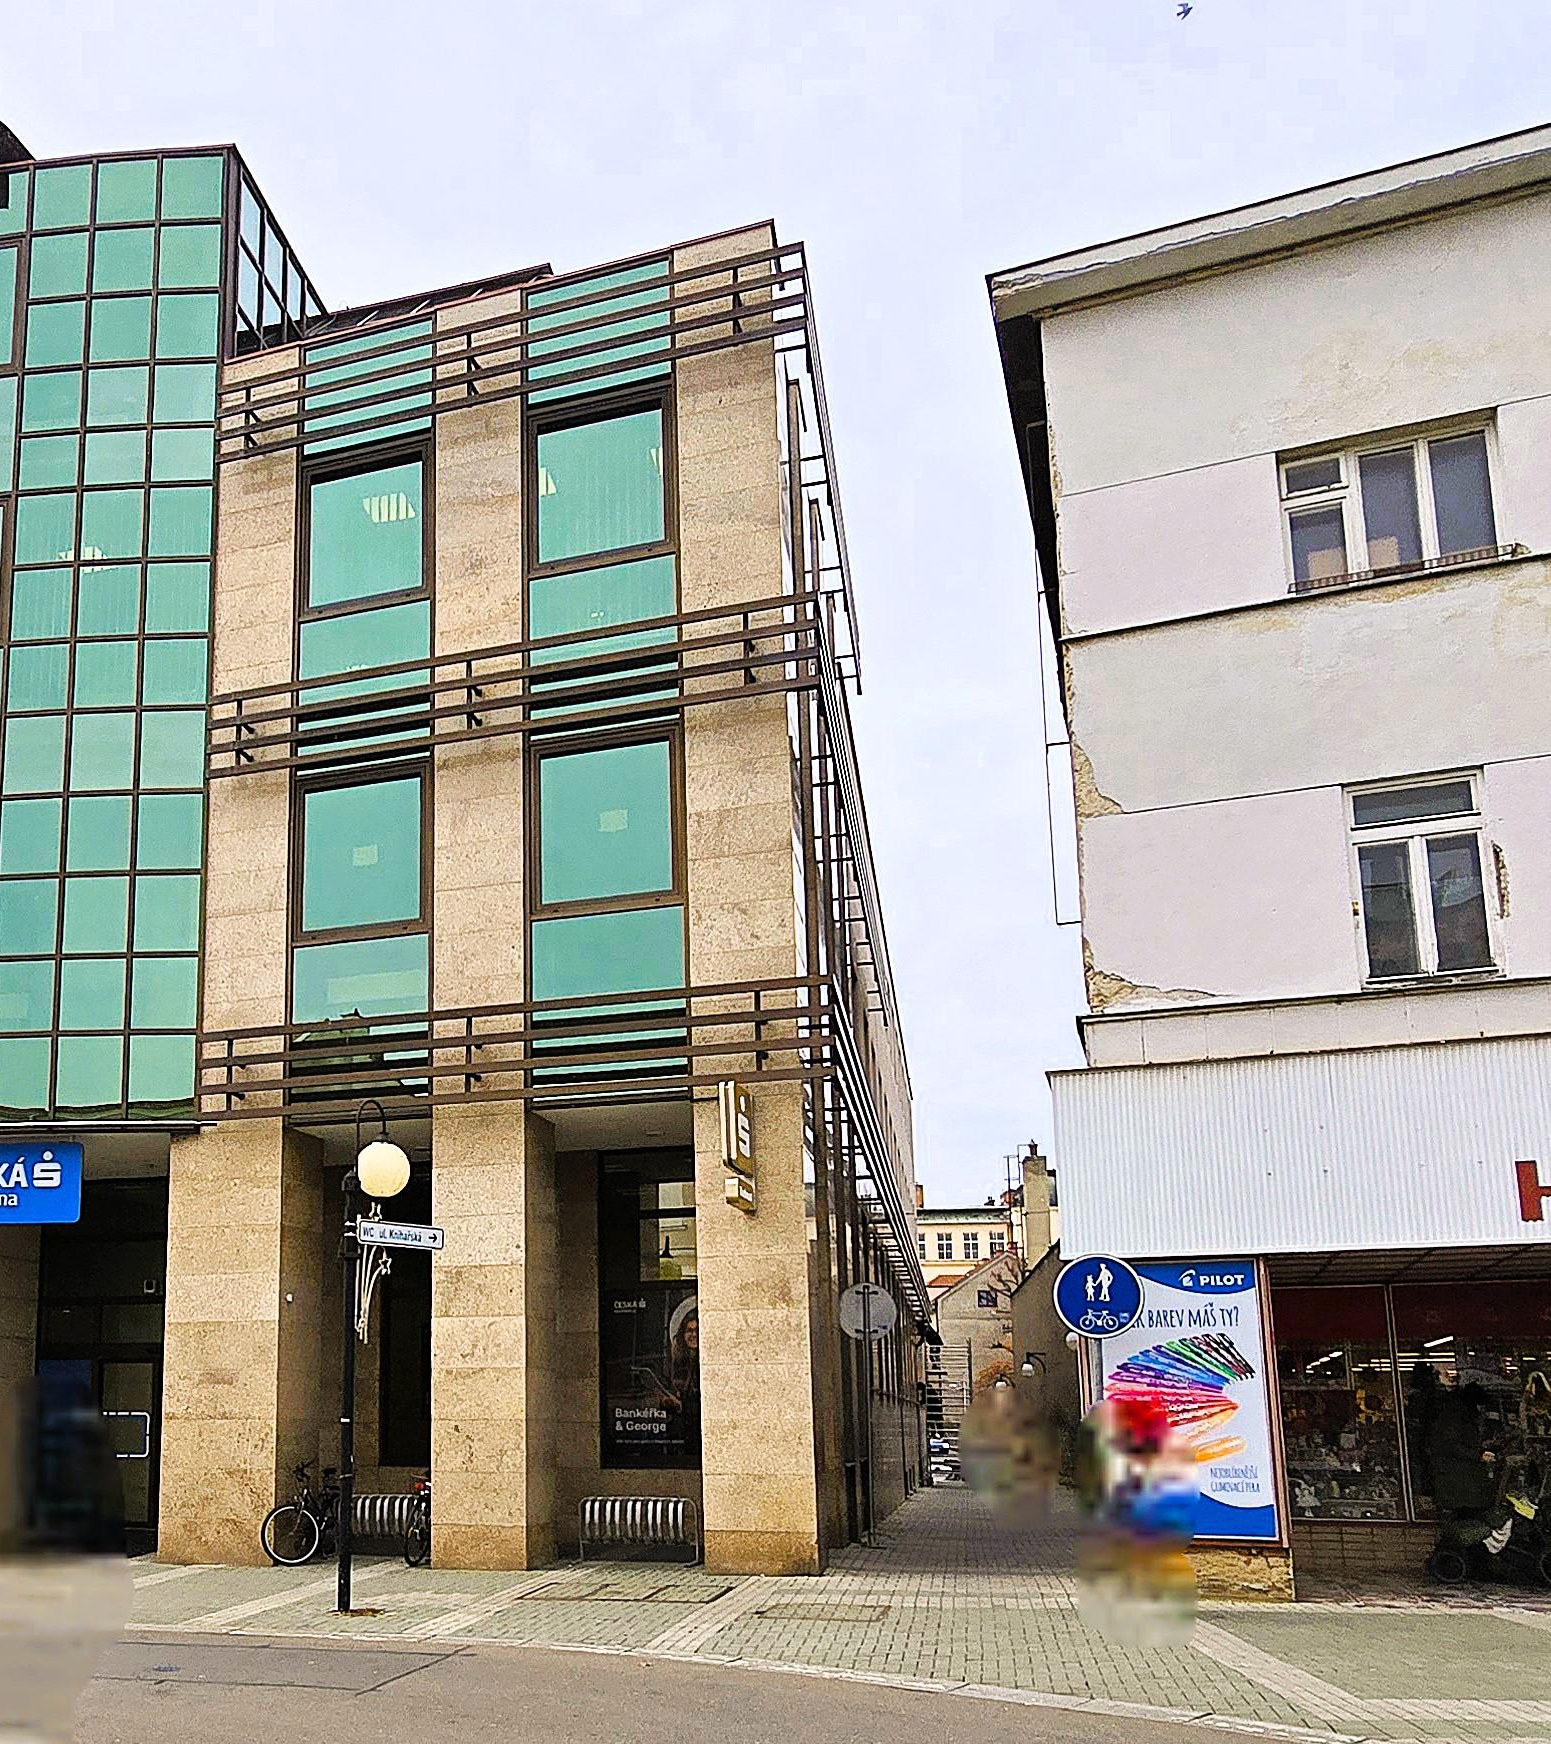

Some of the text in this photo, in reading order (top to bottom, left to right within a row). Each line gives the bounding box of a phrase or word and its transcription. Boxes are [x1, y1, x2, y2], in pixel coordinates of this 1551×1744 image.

[362, 1226, 375, 1238] WC
[1199, 1274, 1245, 1286] PILOT
[1147, 1308, 1184, 1328] BAREV
[1188, 1302, 1217, 1328] MÁŠ
[1219, 1305, 1240, 1327] TY?
[615, 1420, 667, 1434] & George
